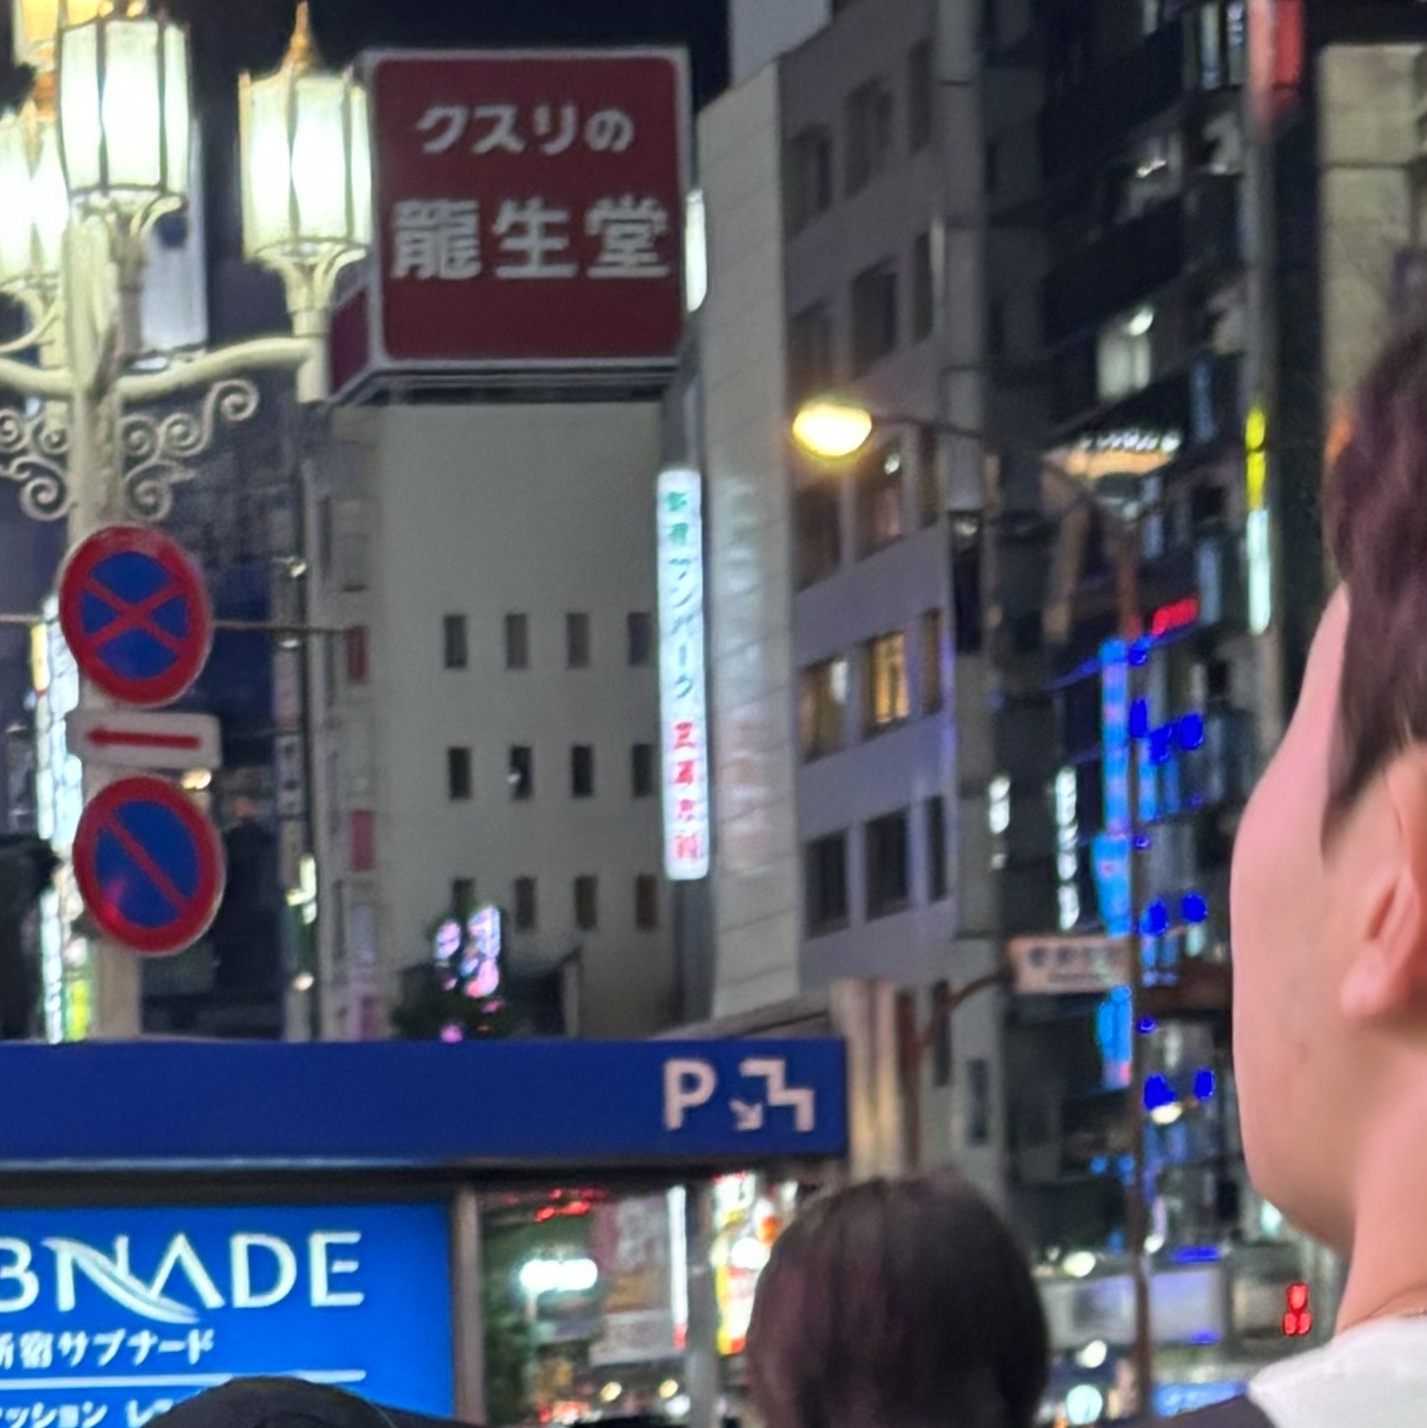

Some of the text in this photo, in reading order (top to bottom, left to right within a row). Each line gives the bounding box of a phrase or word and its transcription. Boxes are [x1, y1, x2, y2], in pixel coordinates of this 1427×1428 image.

[415, 104, 635, 155] クスリの
[390, 195, 671, 280] 龍生堂
[663, 1059, 719, 1131] P
